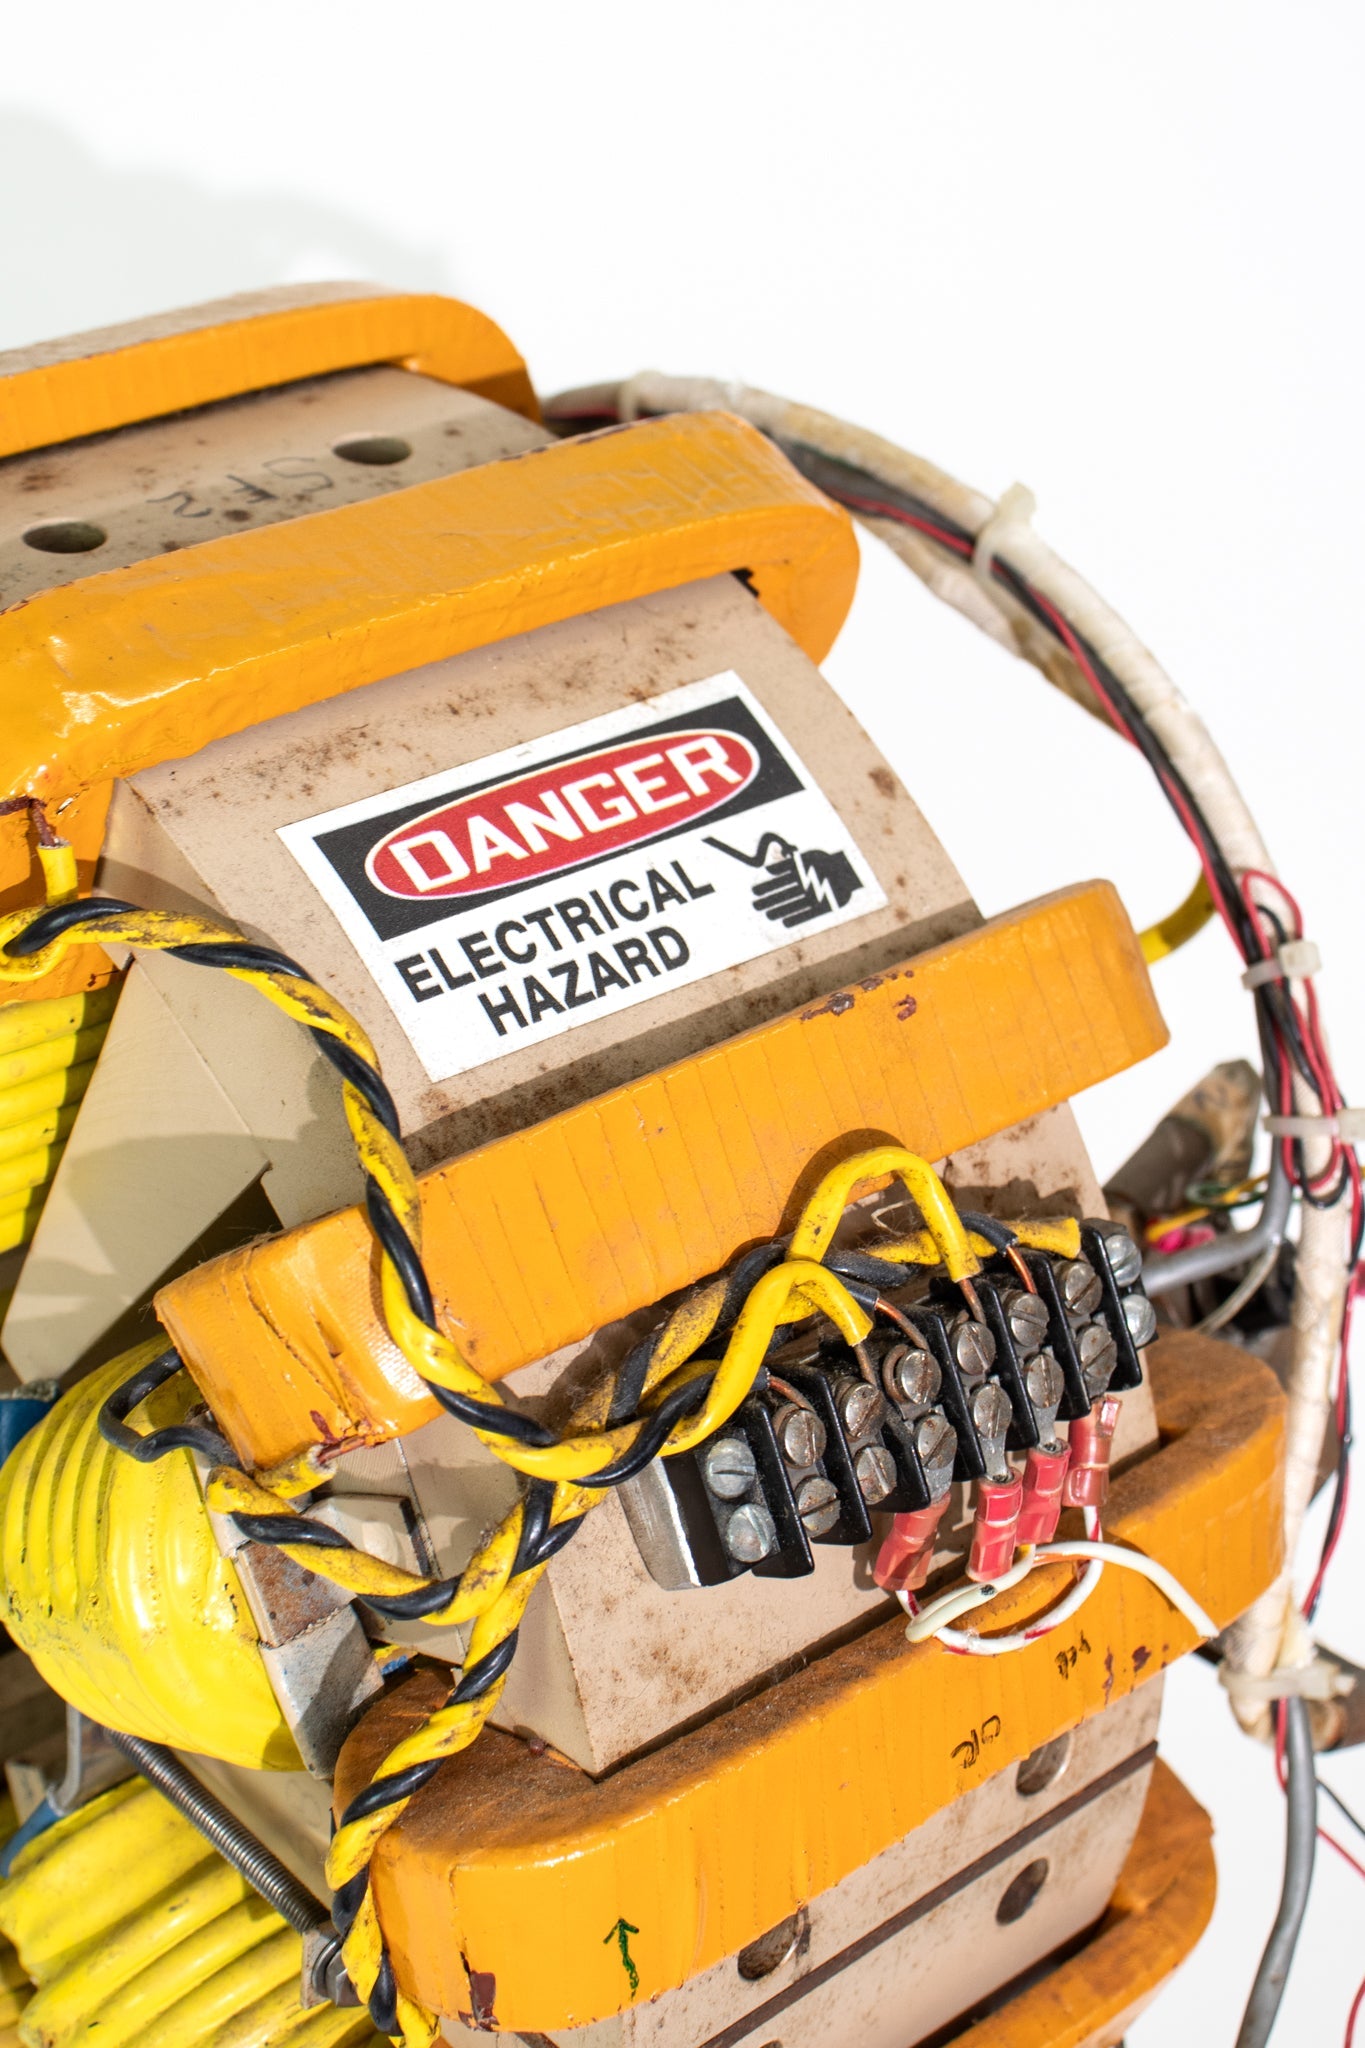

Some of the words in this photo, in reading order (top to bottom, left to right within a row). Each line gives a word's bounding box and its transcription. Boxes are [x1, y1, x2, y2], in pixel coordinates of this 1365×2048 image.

[389, 733, 744, 893] DANGER
[393, 859, 716, 1003] ELECTRICAL
[476, 926, 692, 1037] HAZARD
